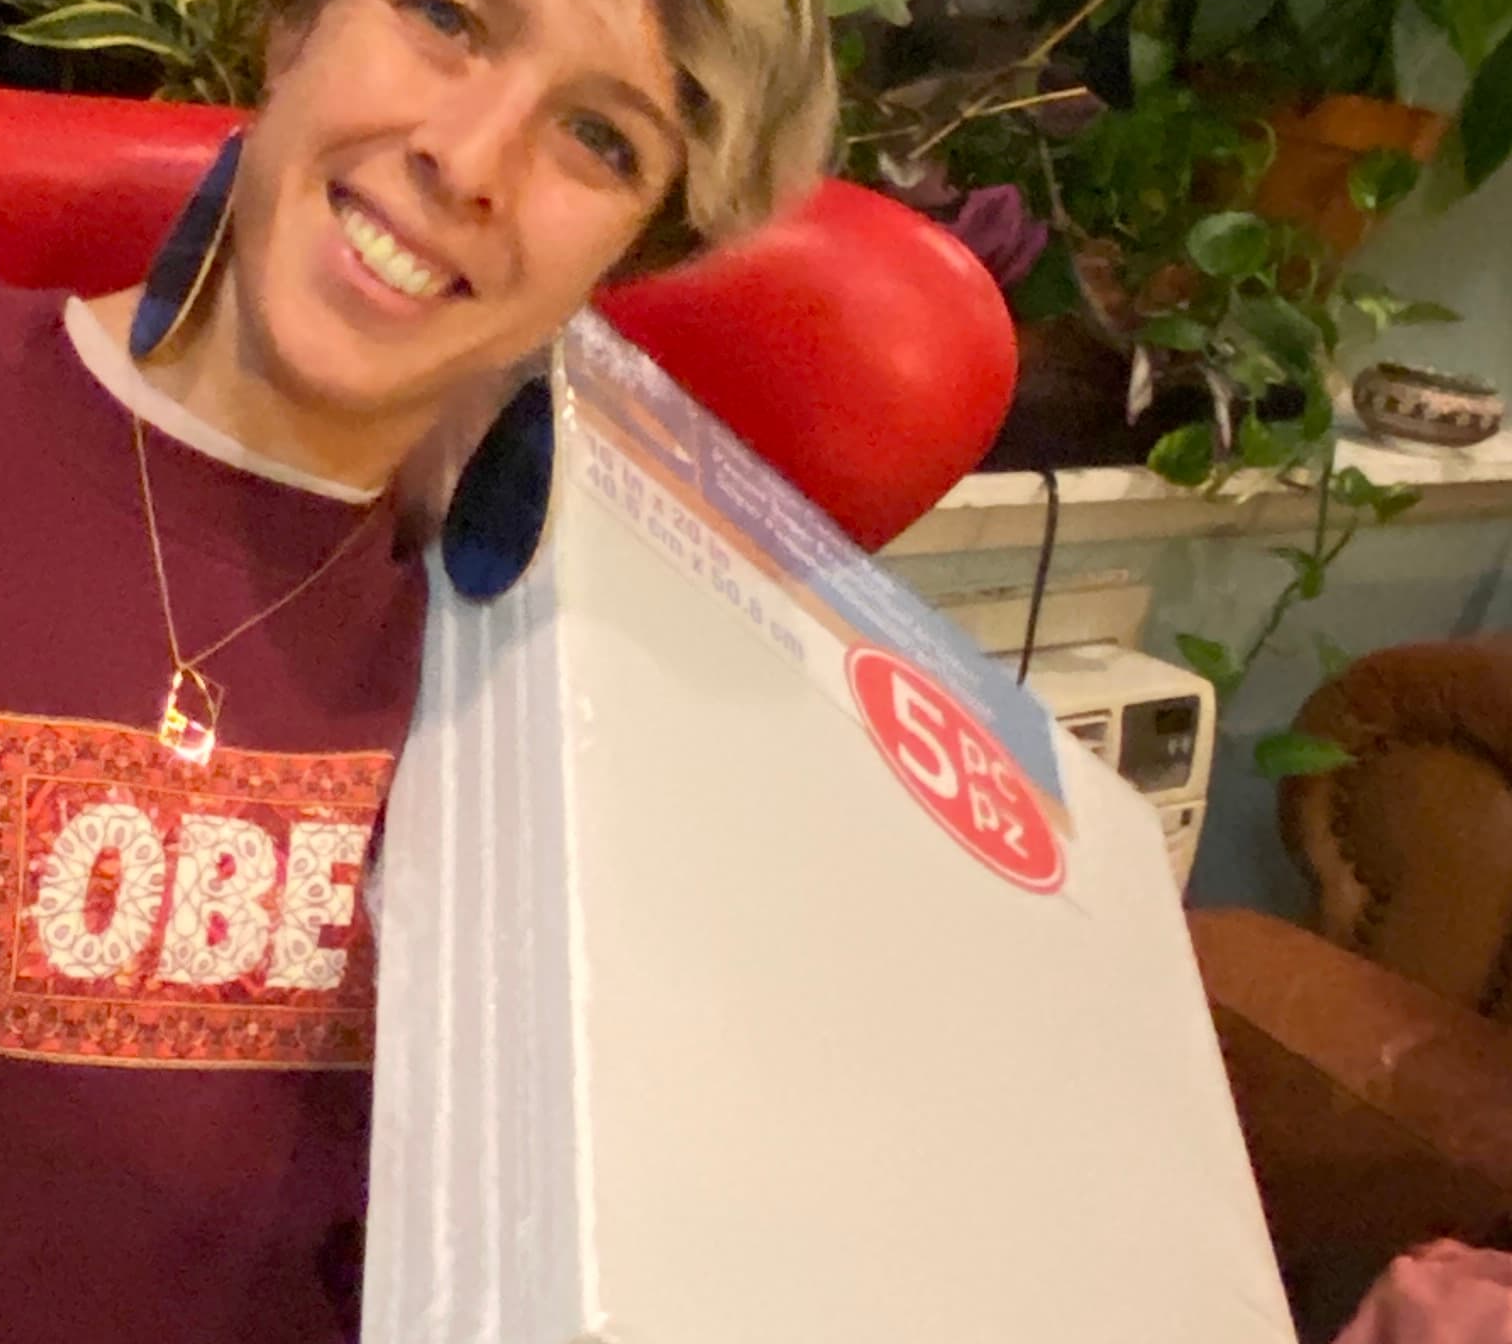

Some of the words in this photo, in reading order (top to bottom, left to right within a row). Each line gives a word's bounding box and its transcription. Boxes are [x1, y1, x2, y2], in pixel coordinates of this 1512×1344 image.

[647, 515, 683, 557] cm
[692, 552, 704, 575] x
[710, 563, 763, 625] 50.8
[770, 620, 805, 663] cm
[673, 506, 701, 545] 20
[891, 670, 959, 800] 5
